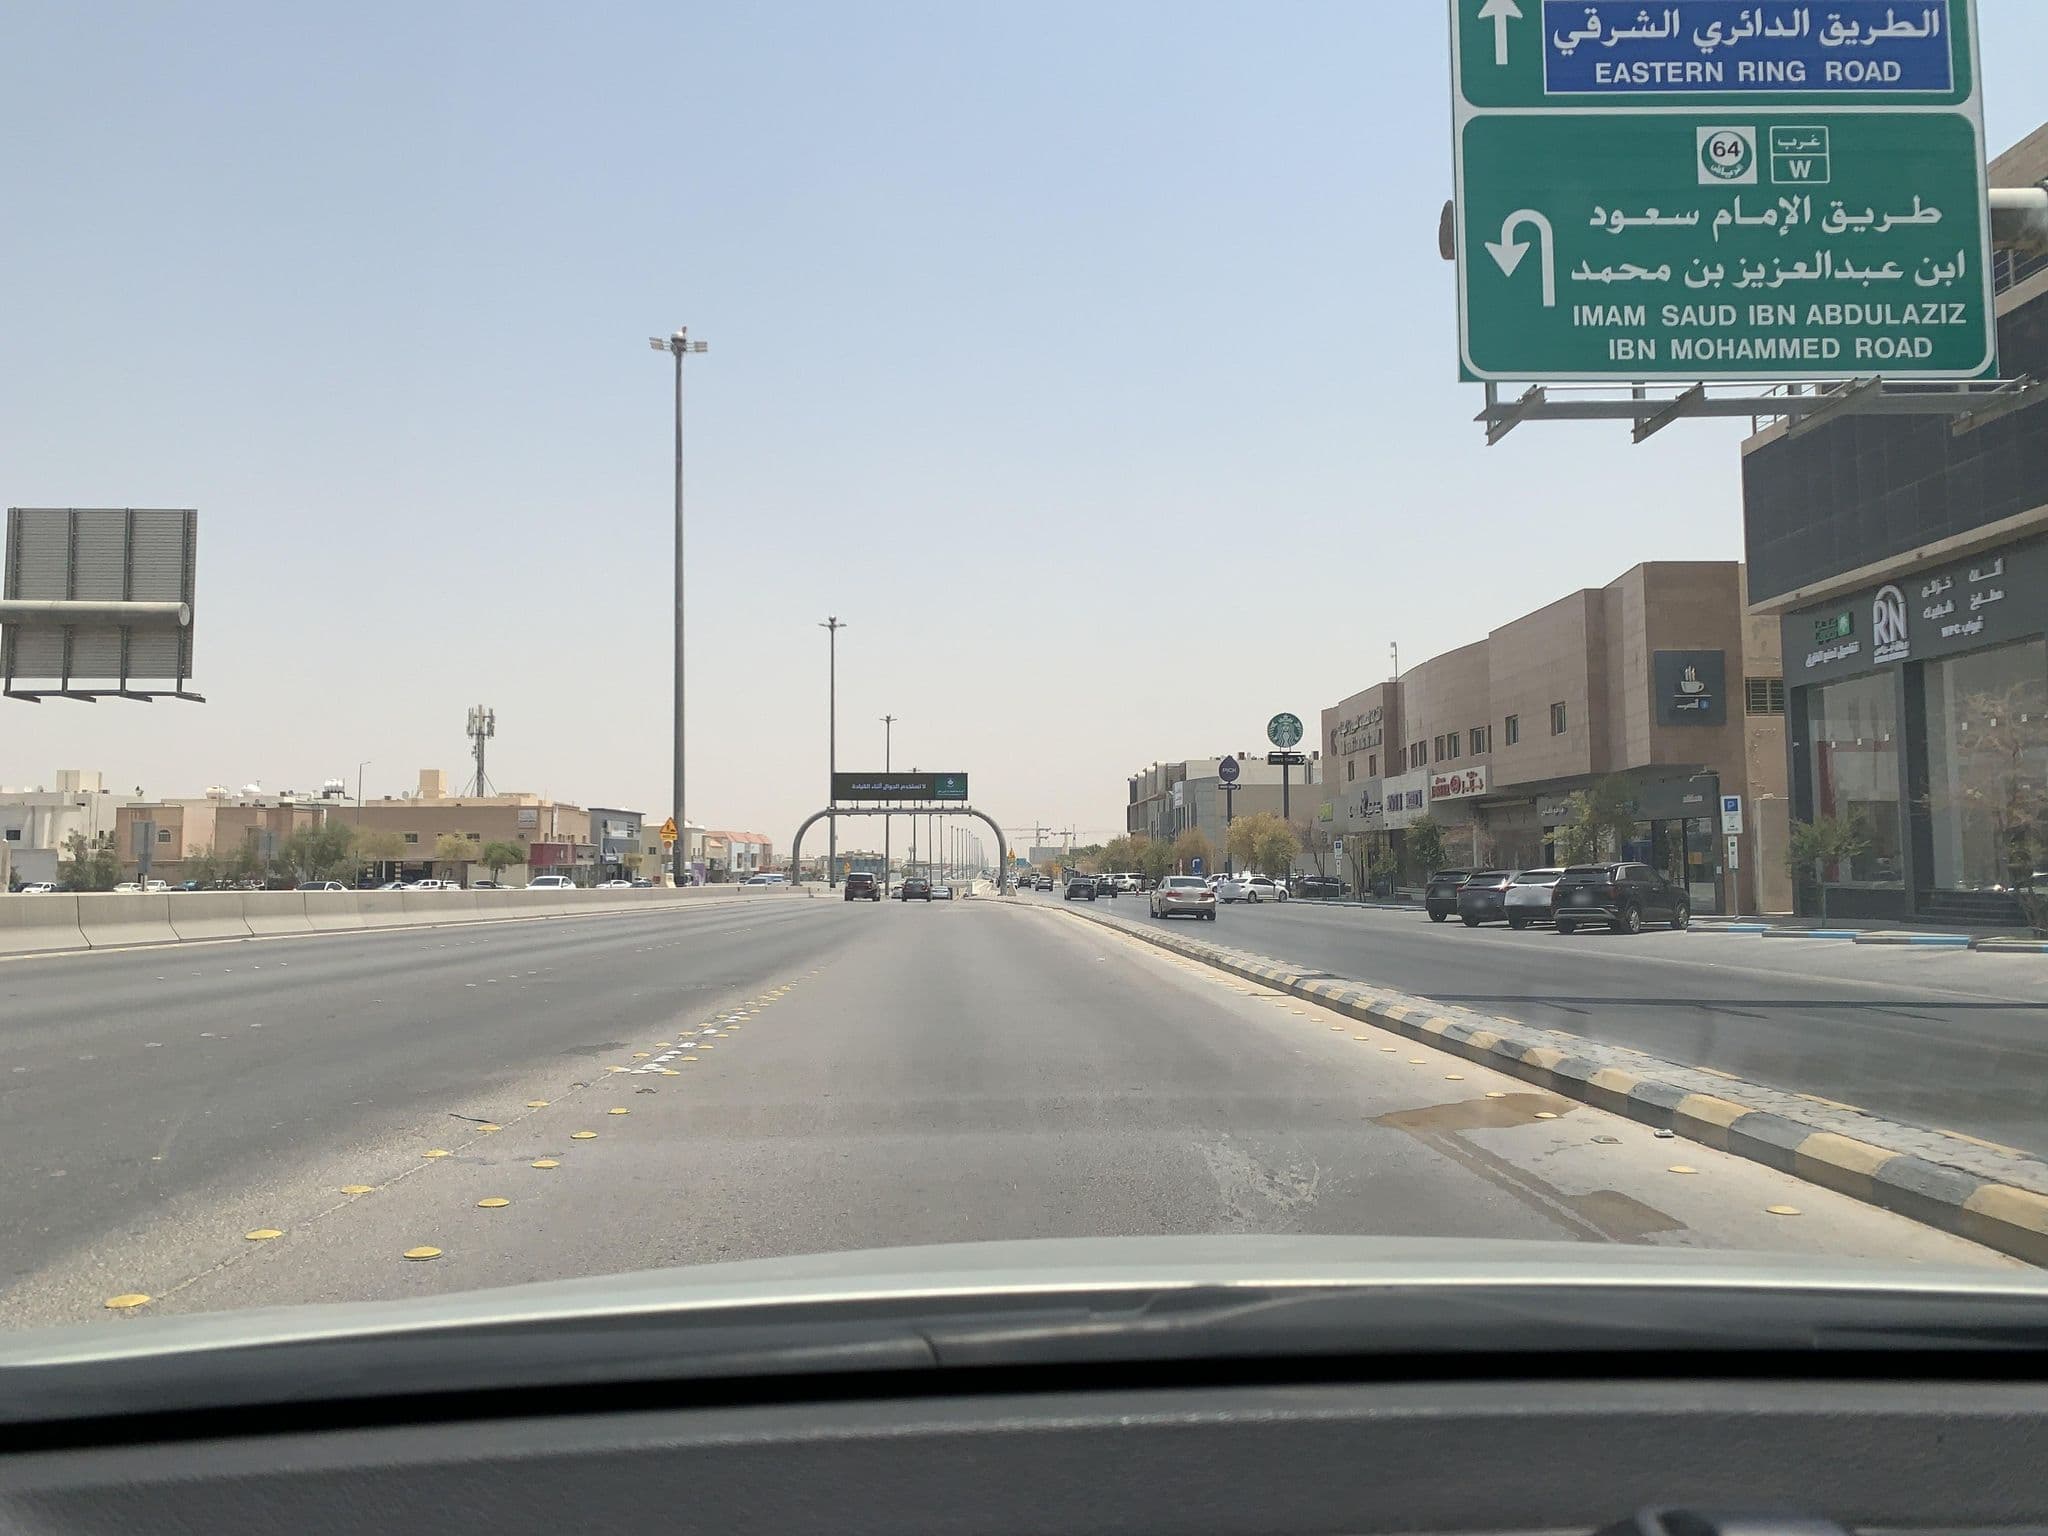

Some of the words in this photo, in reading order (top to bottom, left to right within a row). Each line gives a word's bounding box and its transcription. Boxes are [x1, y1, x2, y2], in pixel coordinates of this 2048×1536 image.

[1554, 8, 1679, 55] الشرقي
[1694, 8, 1809, 53] الدائري
[1820, 9, 1939, 46] الطريق
[1596, 62, 1722, 82] EASTERN
[1739, 61, 1805, 81] RING
[1826, 61, 1901, 81] ROAD
[1713, 140, 1741, 158] 64
[1778, 135, 1820, 149] غرب
[1789, 160, 1811, 178] W
[1590, 206, 1699, 233] سعود
[1713, 195, 1810, 242] الإمام
[1822, 195, 1942, 233] طريق
[1572, 260, 1670, 283] محمد
[1685, 261, 1724, 288] بن
[1915, 250, 1965, 286] ابن
[1574, 306, 1645, 326] IMAM
[1662, 305, 1736, 326] SAUD
[1749, 305, 1795, 325] IBN
[1807, 304, 1966, 325] ABDULAZIZ
[1610, 339, 1655, 359] IBN
[1671, 338, 1840, 359] MOHAMMED
[1856, 337, 1932, 358] ROAD
[1873, 594, 1909, 646] RN
